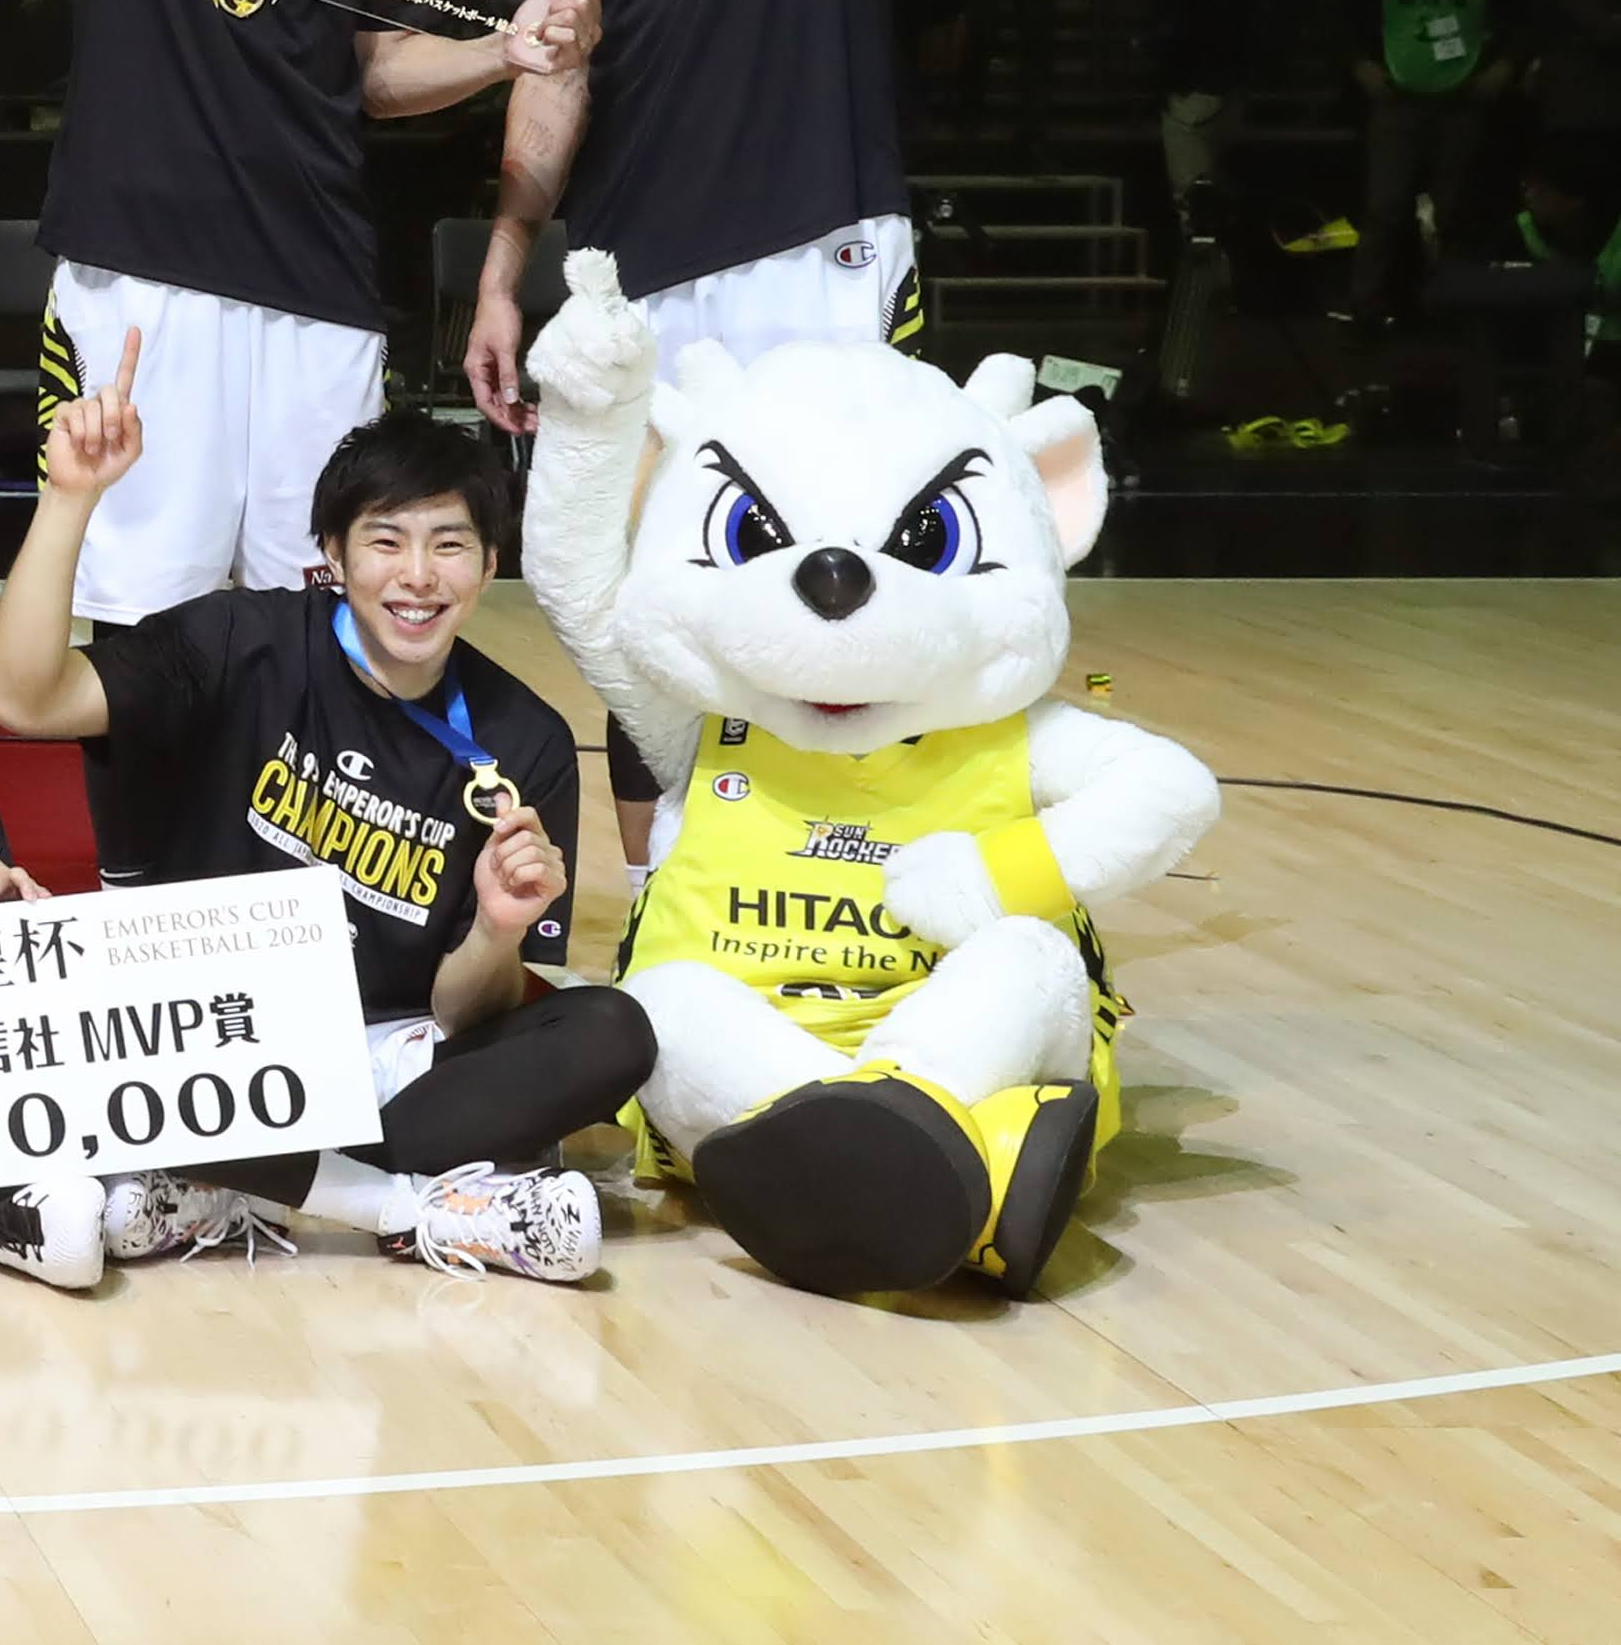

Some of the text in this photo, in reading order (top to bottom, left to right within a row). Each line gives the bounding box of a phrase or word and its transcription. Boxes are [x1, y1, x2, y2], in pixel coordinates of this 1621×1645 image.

[252, 759, 445, 907] CHAMPIONS
[323, 770, 421, 839] EMPEROR'S
[421, 817, 456, 850] CUP
[833, 824, 866, 839] SUN
[272, 828, 291, 846] ALL
[352, 882, 421, 919] CHAMPIONSHIP
[102, 898, 301, 940] EMPEROR'S CUP
[729, 886, 911, 940] HITAC
[107, 923, 324, 967] BASKETBALL 2020
[711, 931, 828, 965] Inspire
[842, 945, 897, 971] the
[78, 992, 260, 1064] MVP賞
